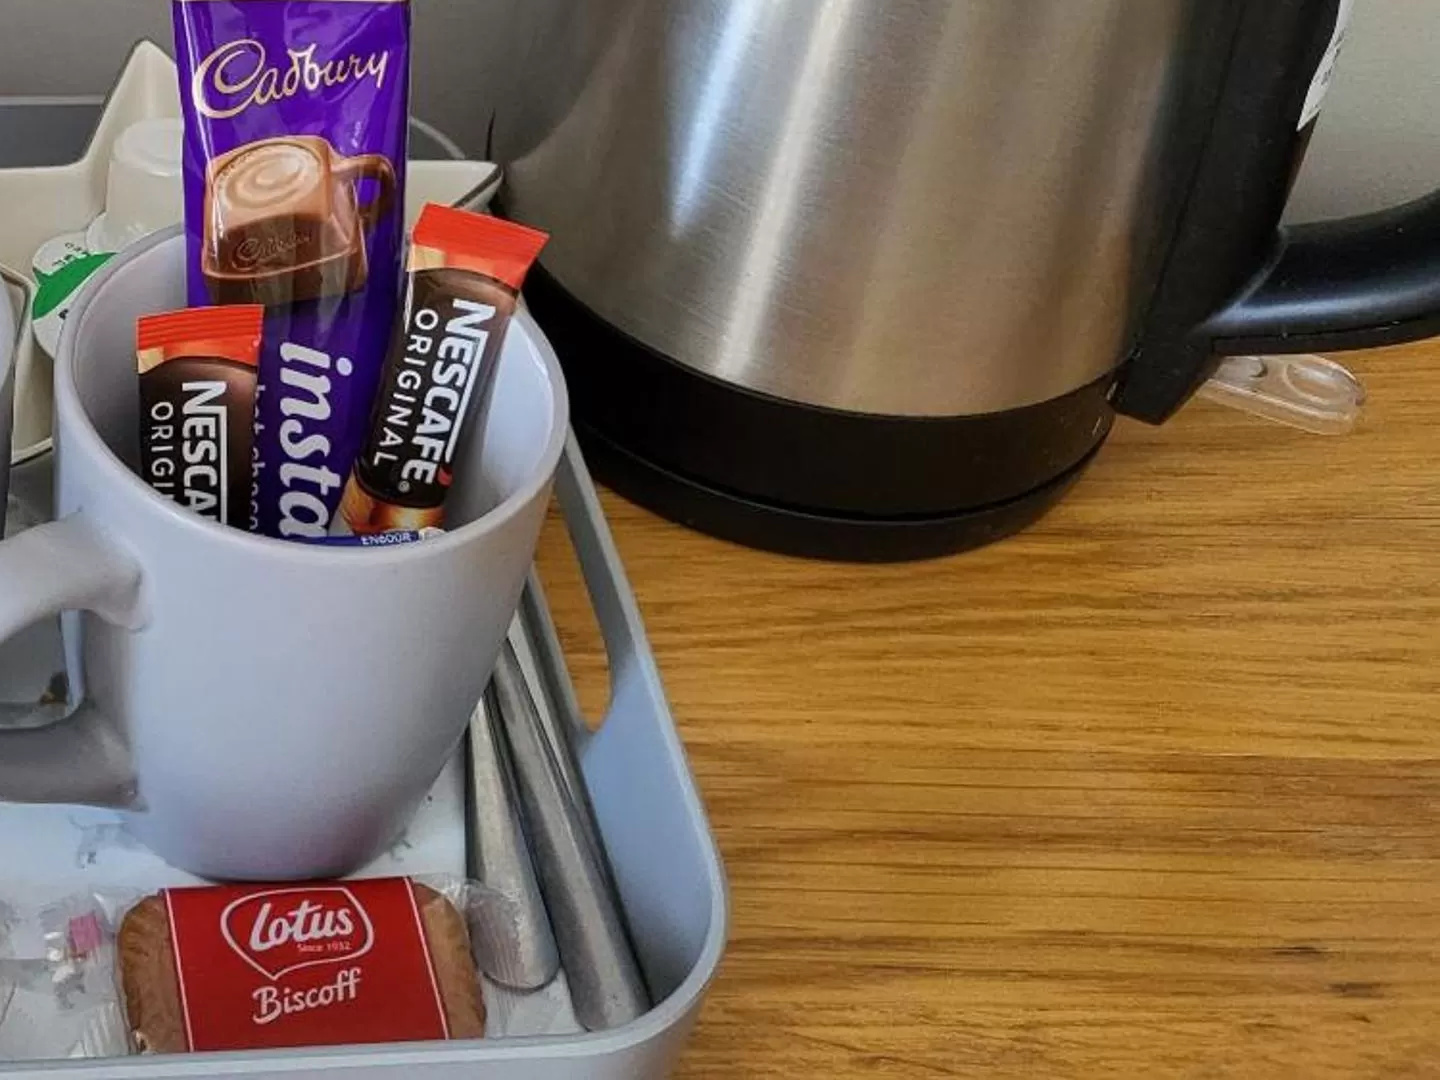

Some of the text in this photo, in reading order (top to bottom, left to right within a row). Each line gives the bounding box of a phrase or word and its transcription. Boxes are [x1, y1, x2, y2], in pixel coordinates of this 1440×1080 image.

[192, 38, 389, 119] Cadbury
[373, 308, 438, 467] ORIGINAL
[279, 341, 354, 538] insta
[251, 899, 354, 952] Lotus
[253, 968, 361, 1024] Biscoff
